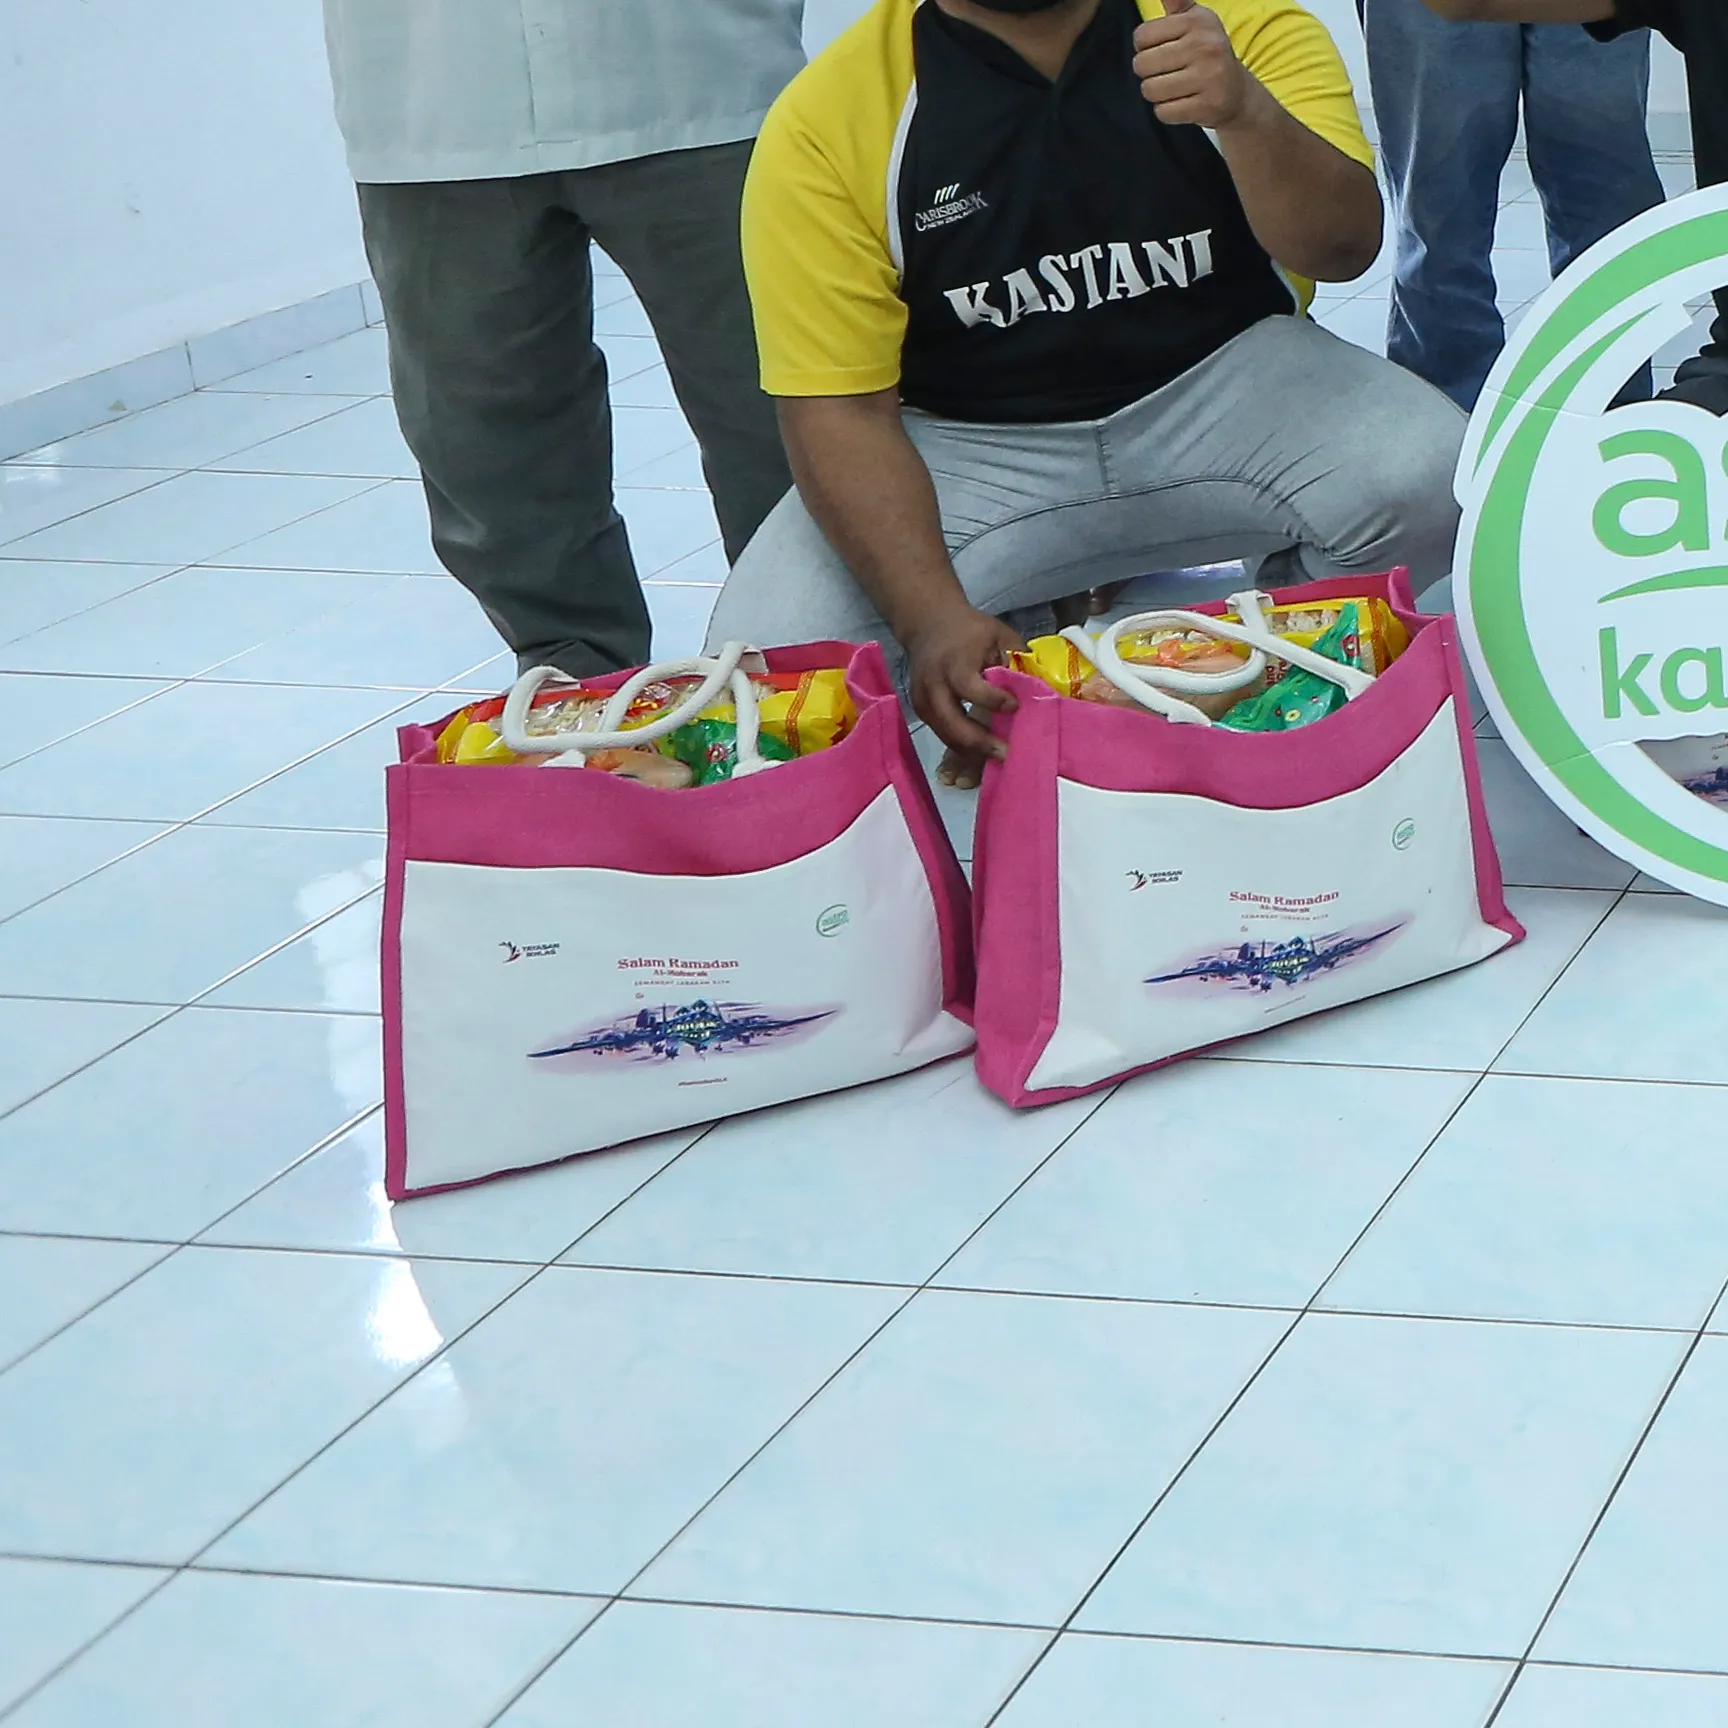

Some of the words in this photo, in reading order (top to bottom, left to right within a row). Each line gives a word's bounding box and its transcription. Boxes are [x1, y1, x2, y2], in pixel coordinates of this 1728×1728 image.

[943, 228, 1214, 329] KASTANI
[1229, 891, 1271, 904] Salam
[1274, 891, 1340, 906] Ramadan
[616, 957, 666, 969] Salam
[668, 957, 740, 969] Ramadan
